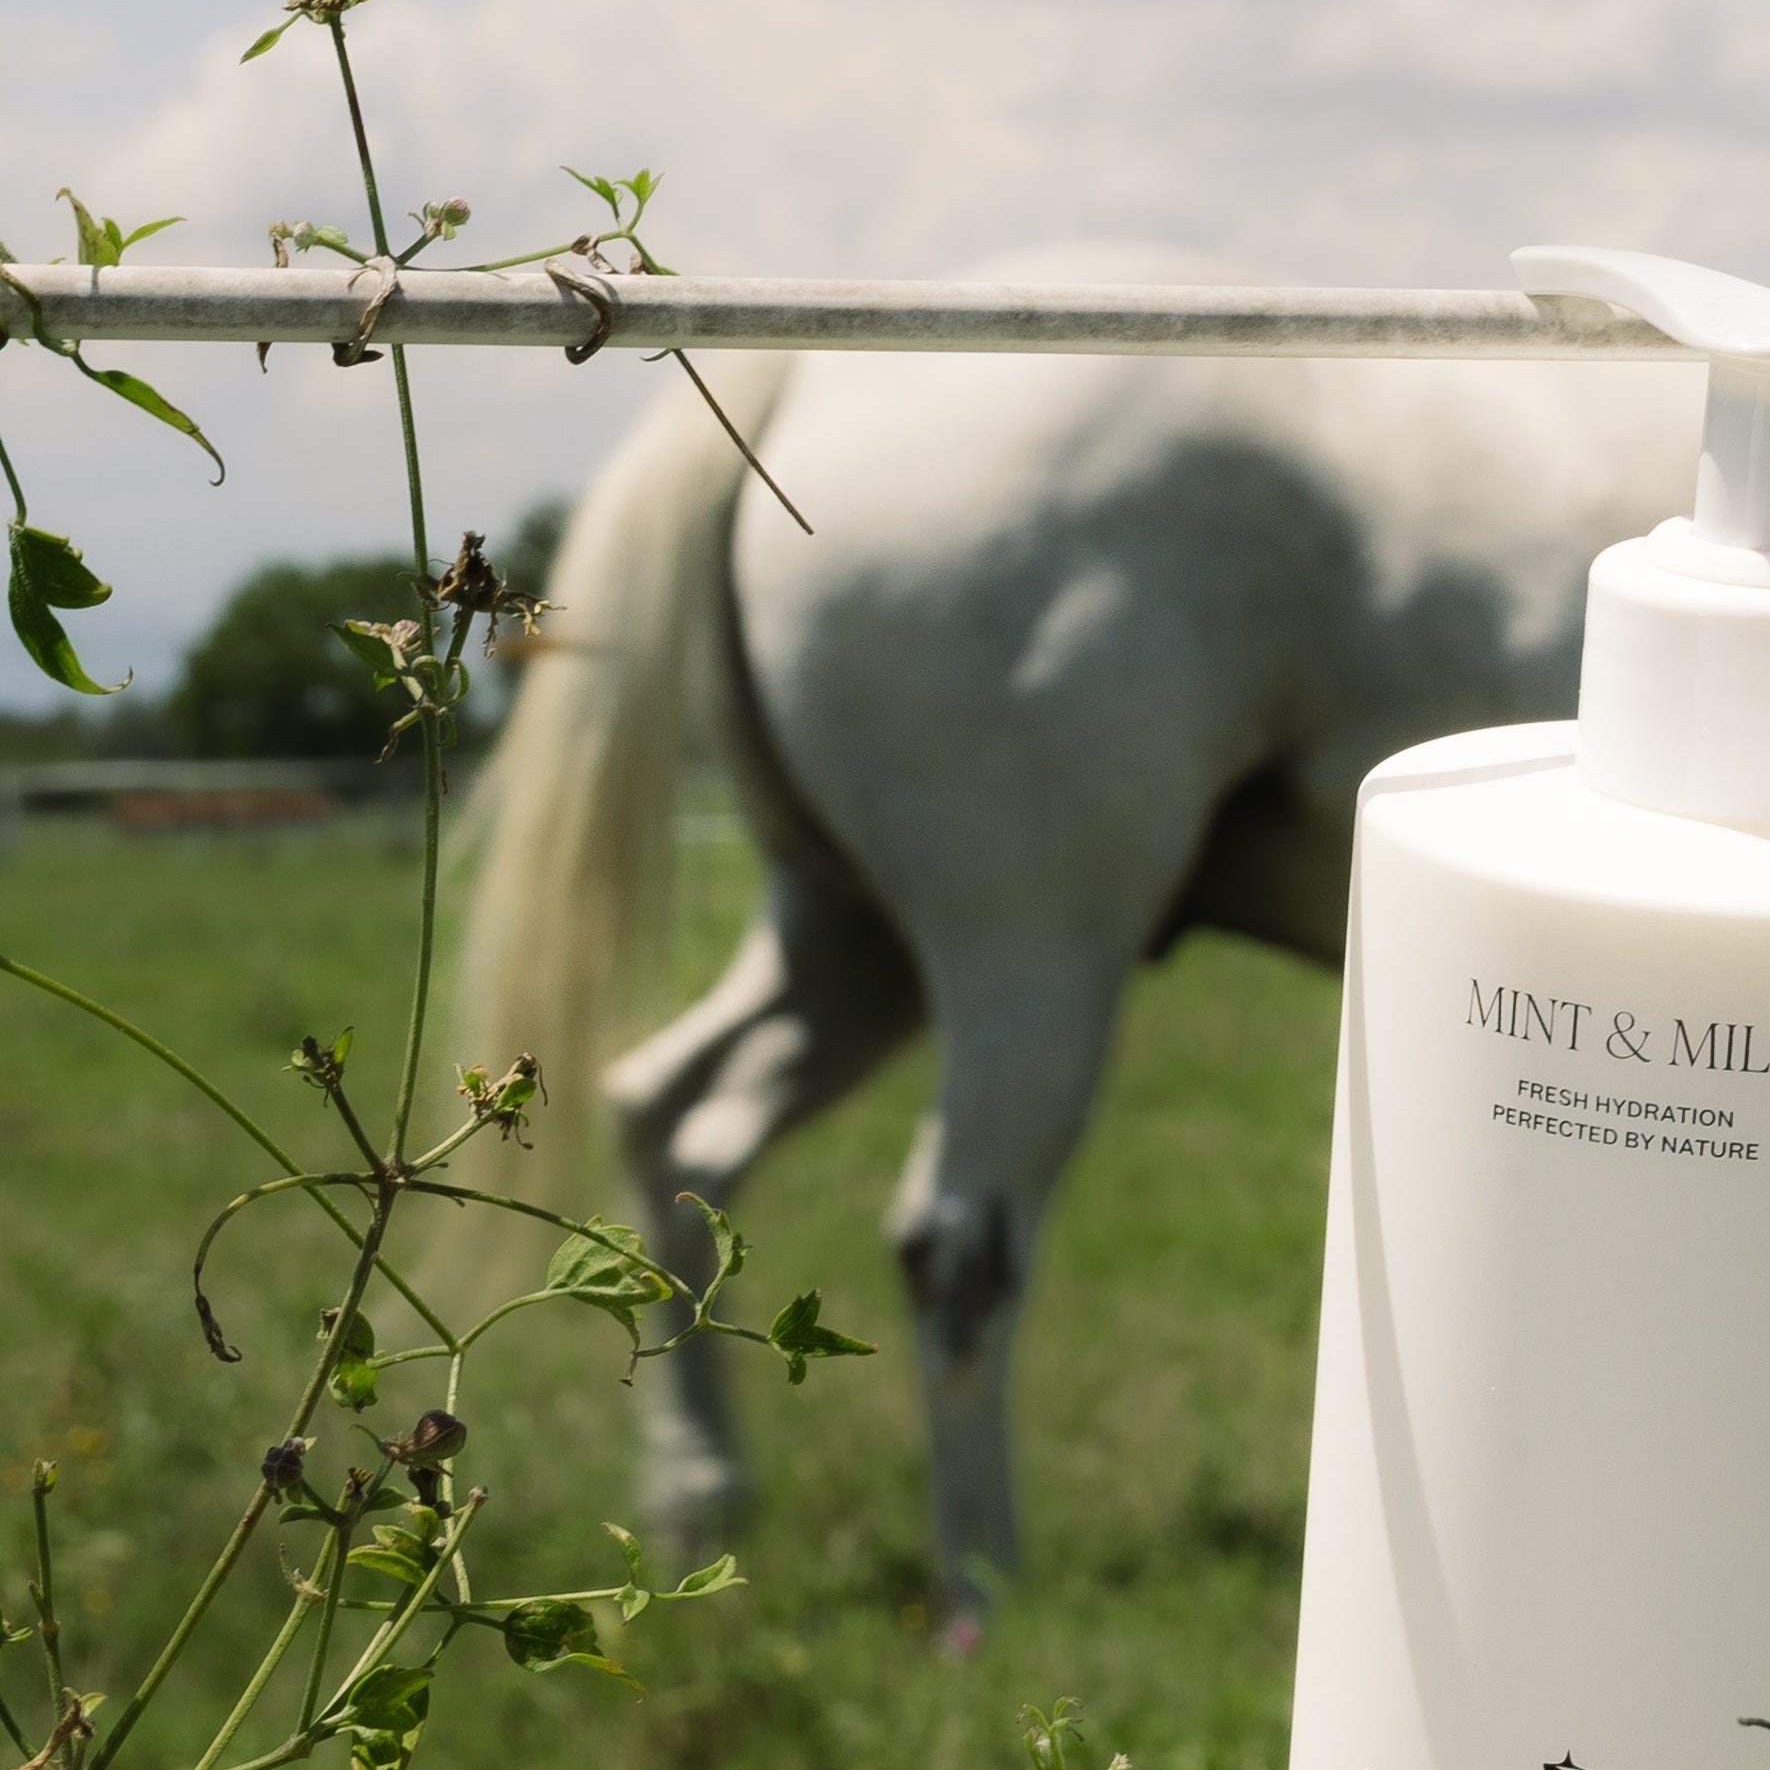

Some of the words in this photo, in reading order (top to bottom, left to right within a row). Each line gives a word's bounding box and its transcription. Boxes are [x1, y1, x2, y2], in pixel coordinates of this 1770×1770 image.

[1464, 977, 1593, 1052] MINT
[1605, 1010, 1653, 1064] &
[1491, 1103, 1619, 1147] PERFECTED
[1623, 1130, 1656, 1153] BY
[1660, 1135, 1760, 1162] NATURE
[1517, 1079, 1590, 1111] FRESH
[1594, 1094, 1735, 1129] HYDRATION
